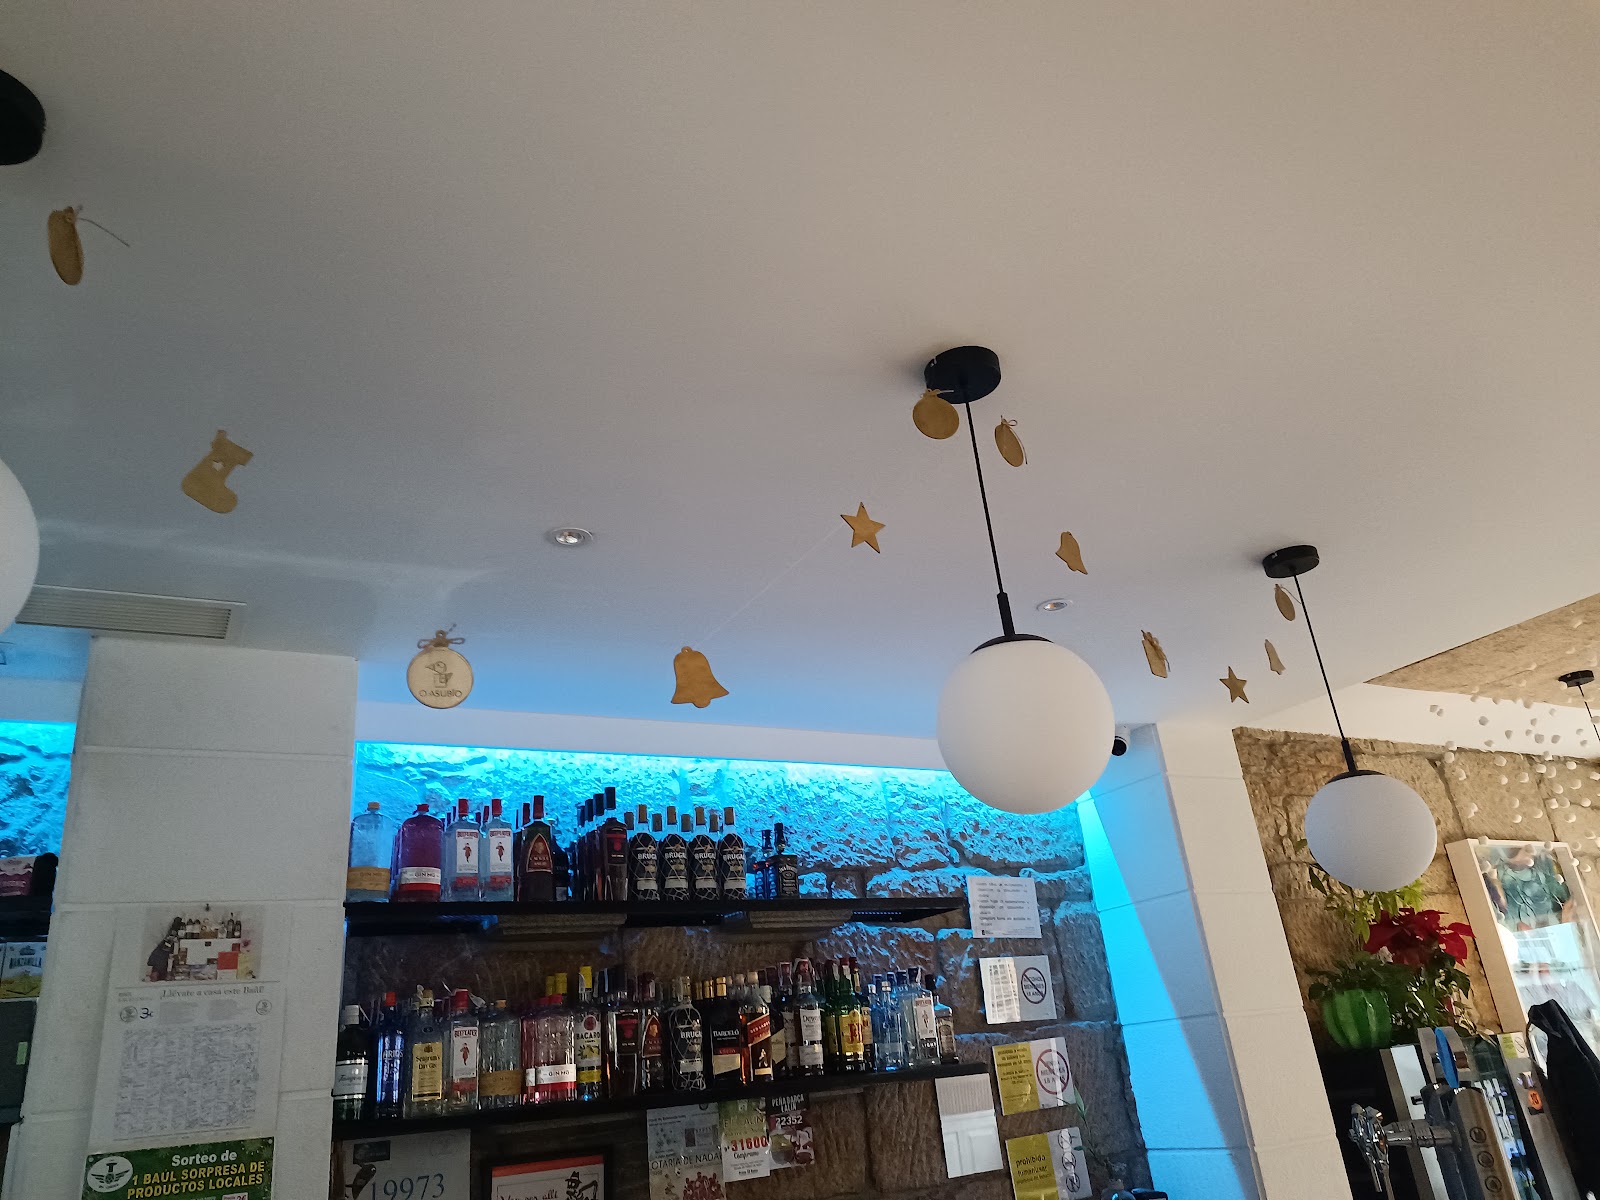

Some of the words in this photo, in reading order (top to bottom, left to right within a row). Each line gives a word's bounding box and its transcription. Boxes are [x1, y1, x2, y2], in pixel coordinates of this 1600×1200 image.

[419, 689, 427, 697] O
[775, 1115, 803, 1126] 22352
[171, 1151, 217, 1167] Sorteo
[221, 1149, 238, 1161] de
[132, 1175, 138, 1186] 1
[181, 1162, 246, 1180] SORPRESA
[250, 1160, 265, 1172] DE
[127, 1180, 205, 1200] PRODUCTOS
[208, 1173, 264, 1190] LOCALES
